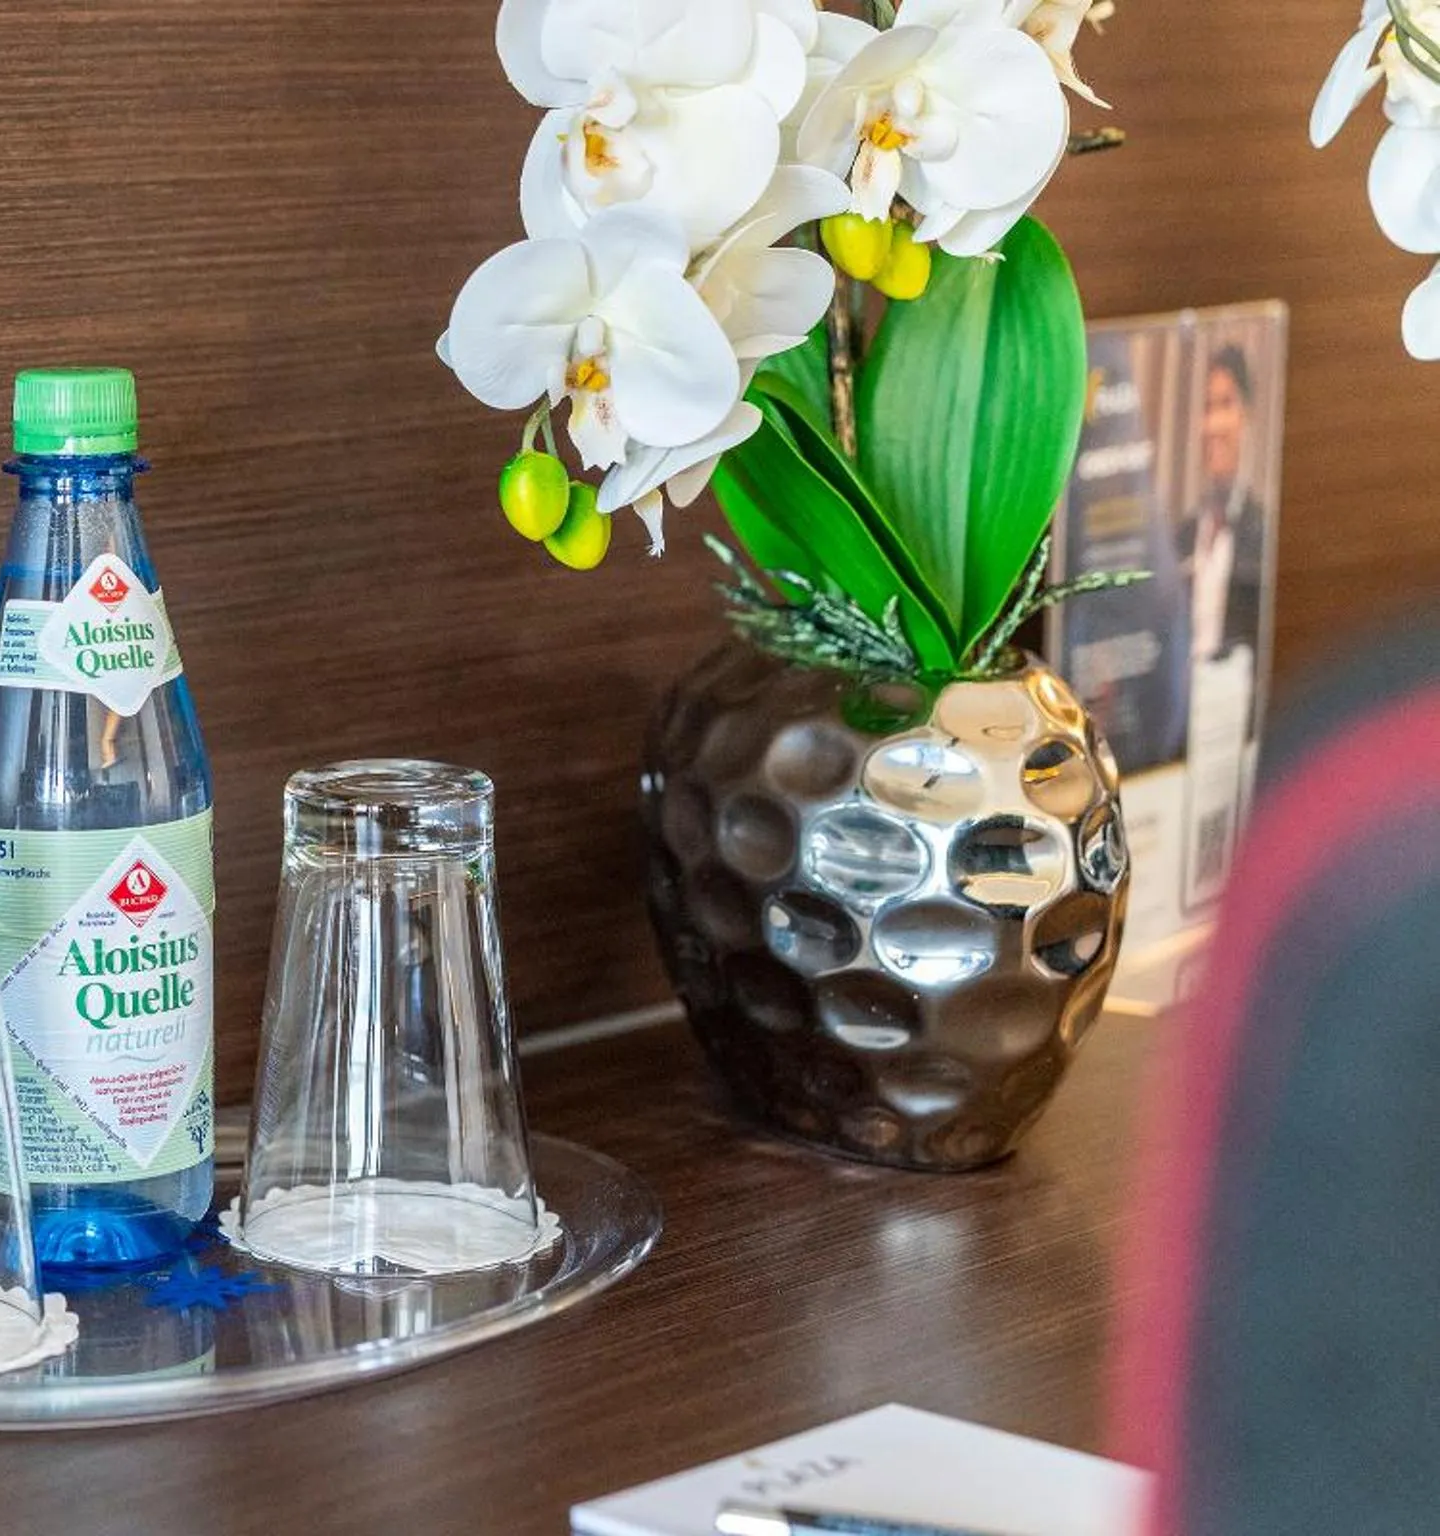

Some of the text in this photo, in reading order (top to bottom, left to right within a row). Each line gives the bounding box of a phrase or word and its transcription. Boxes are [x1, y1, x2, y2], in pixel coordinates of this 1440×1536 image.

[64, 618, 155, 648] Aloisius
[76, 646, 154, 678] Quelle
[58, 930, 200, 977] Aloisius
[75, 974, 195, 1030] Quelle
[87, 1016, 186, 1051] naturell
